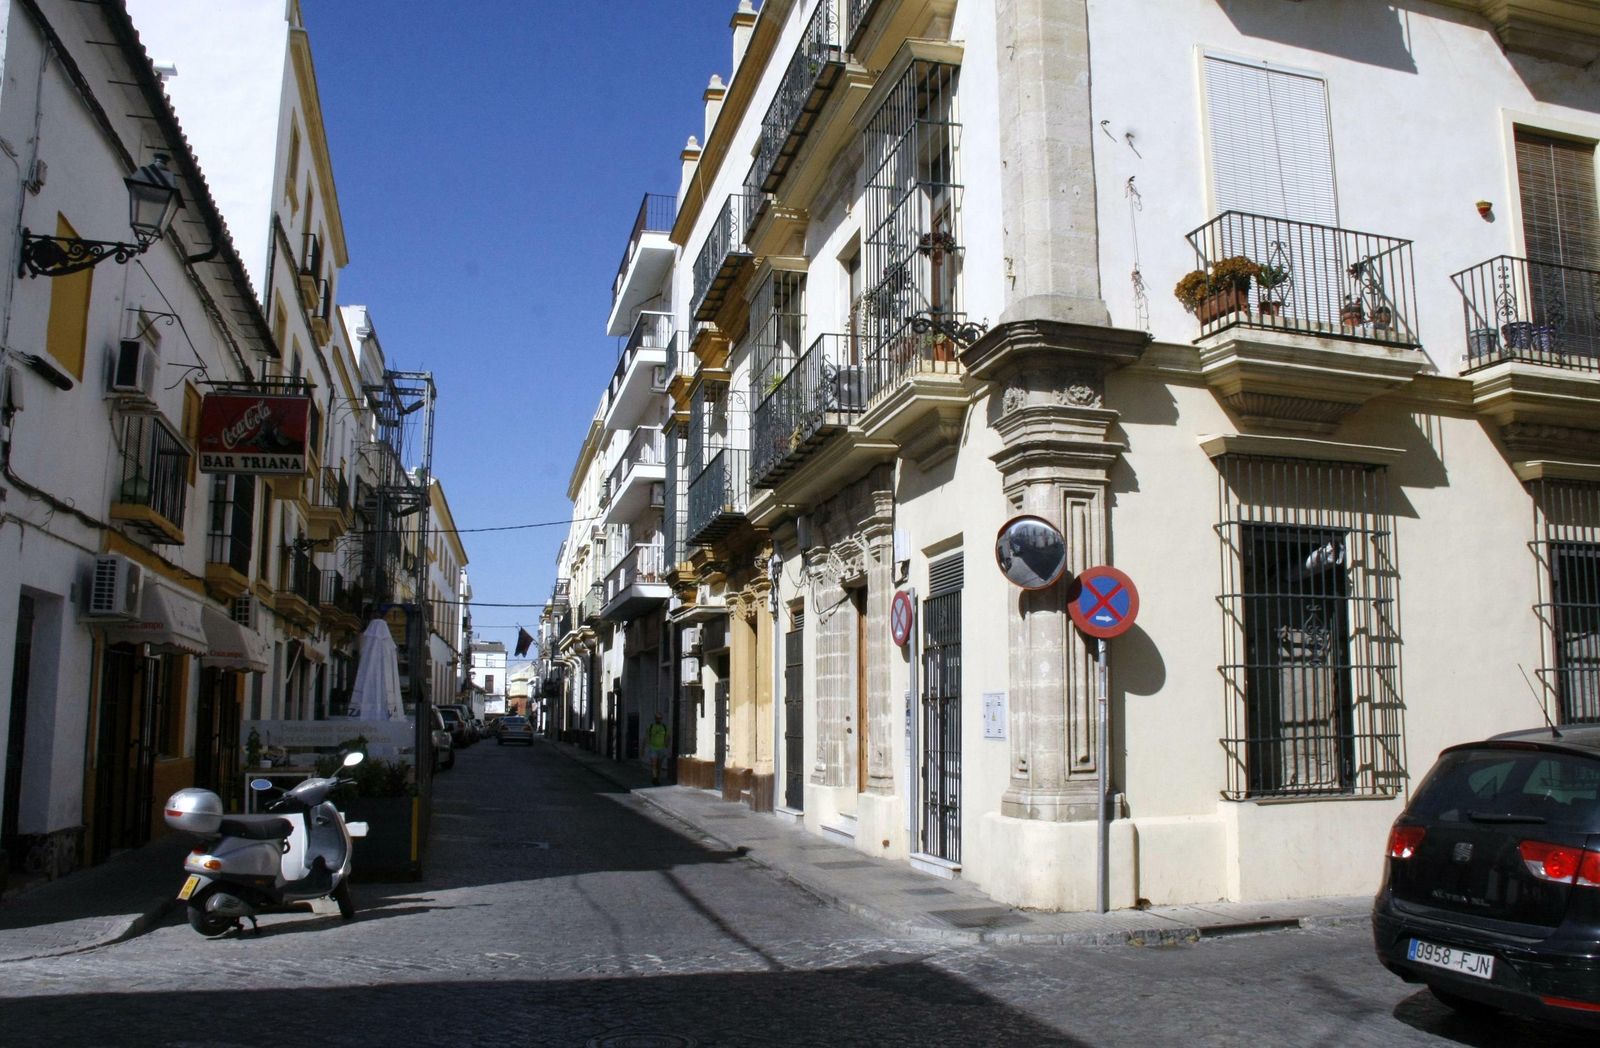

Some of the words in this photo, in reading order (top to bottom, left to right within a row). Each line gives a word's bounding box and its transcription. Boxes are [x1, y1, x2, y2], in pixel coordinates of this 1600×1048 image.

[203, 455, 234, 468] BAR
[241, 456, 301, 469] TRIANA
[1416, 942, 1451, 965] 0958
[1460, 952, 1490, 976] FJN
